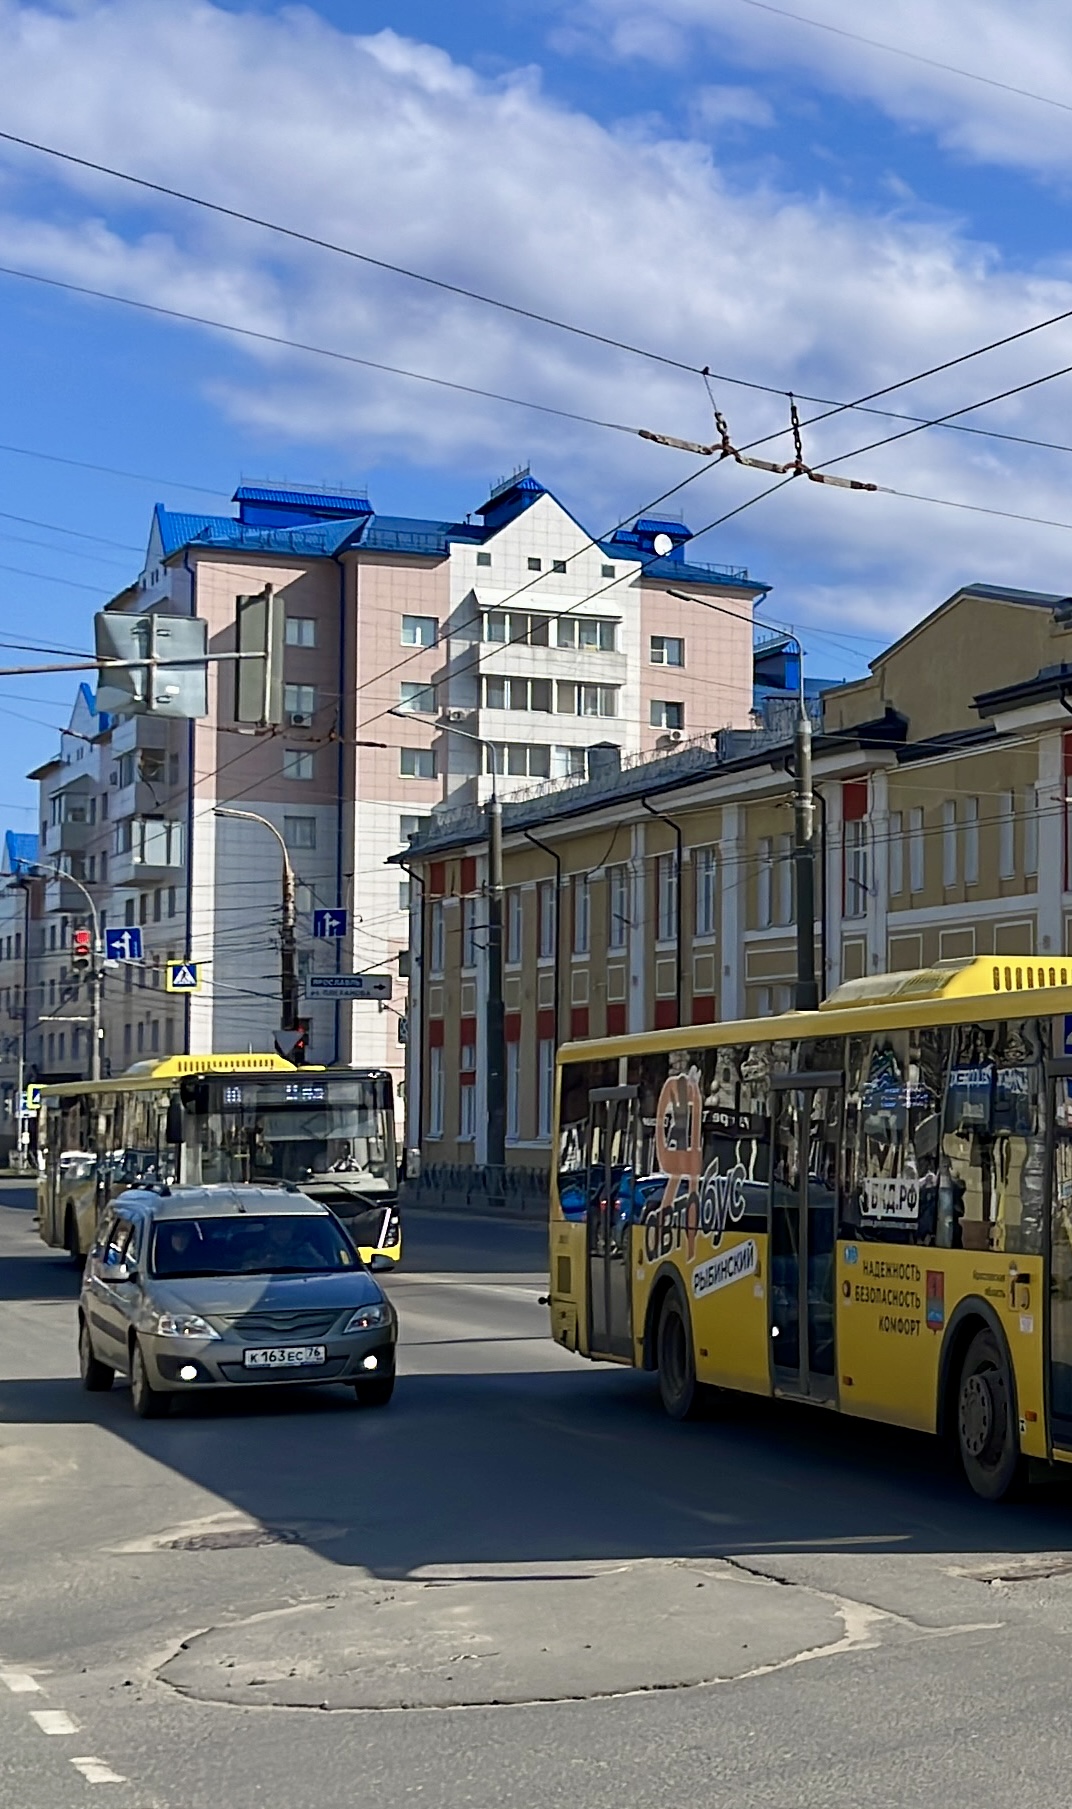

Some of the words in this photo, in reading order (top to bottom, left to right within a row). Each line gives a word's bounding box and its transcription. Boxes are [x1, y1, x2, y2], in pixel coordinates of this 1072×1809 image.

[694, 1241, 755, 1293] РЫБИНСКИЙ
[863, 1260, 921, 1281] НАДЕЖНОСТЬ
[855, 1285, 921, 1309] БЕЗОПАСНОСТЬ
[879, 1316, 921, 1336] КОМФОРТ
